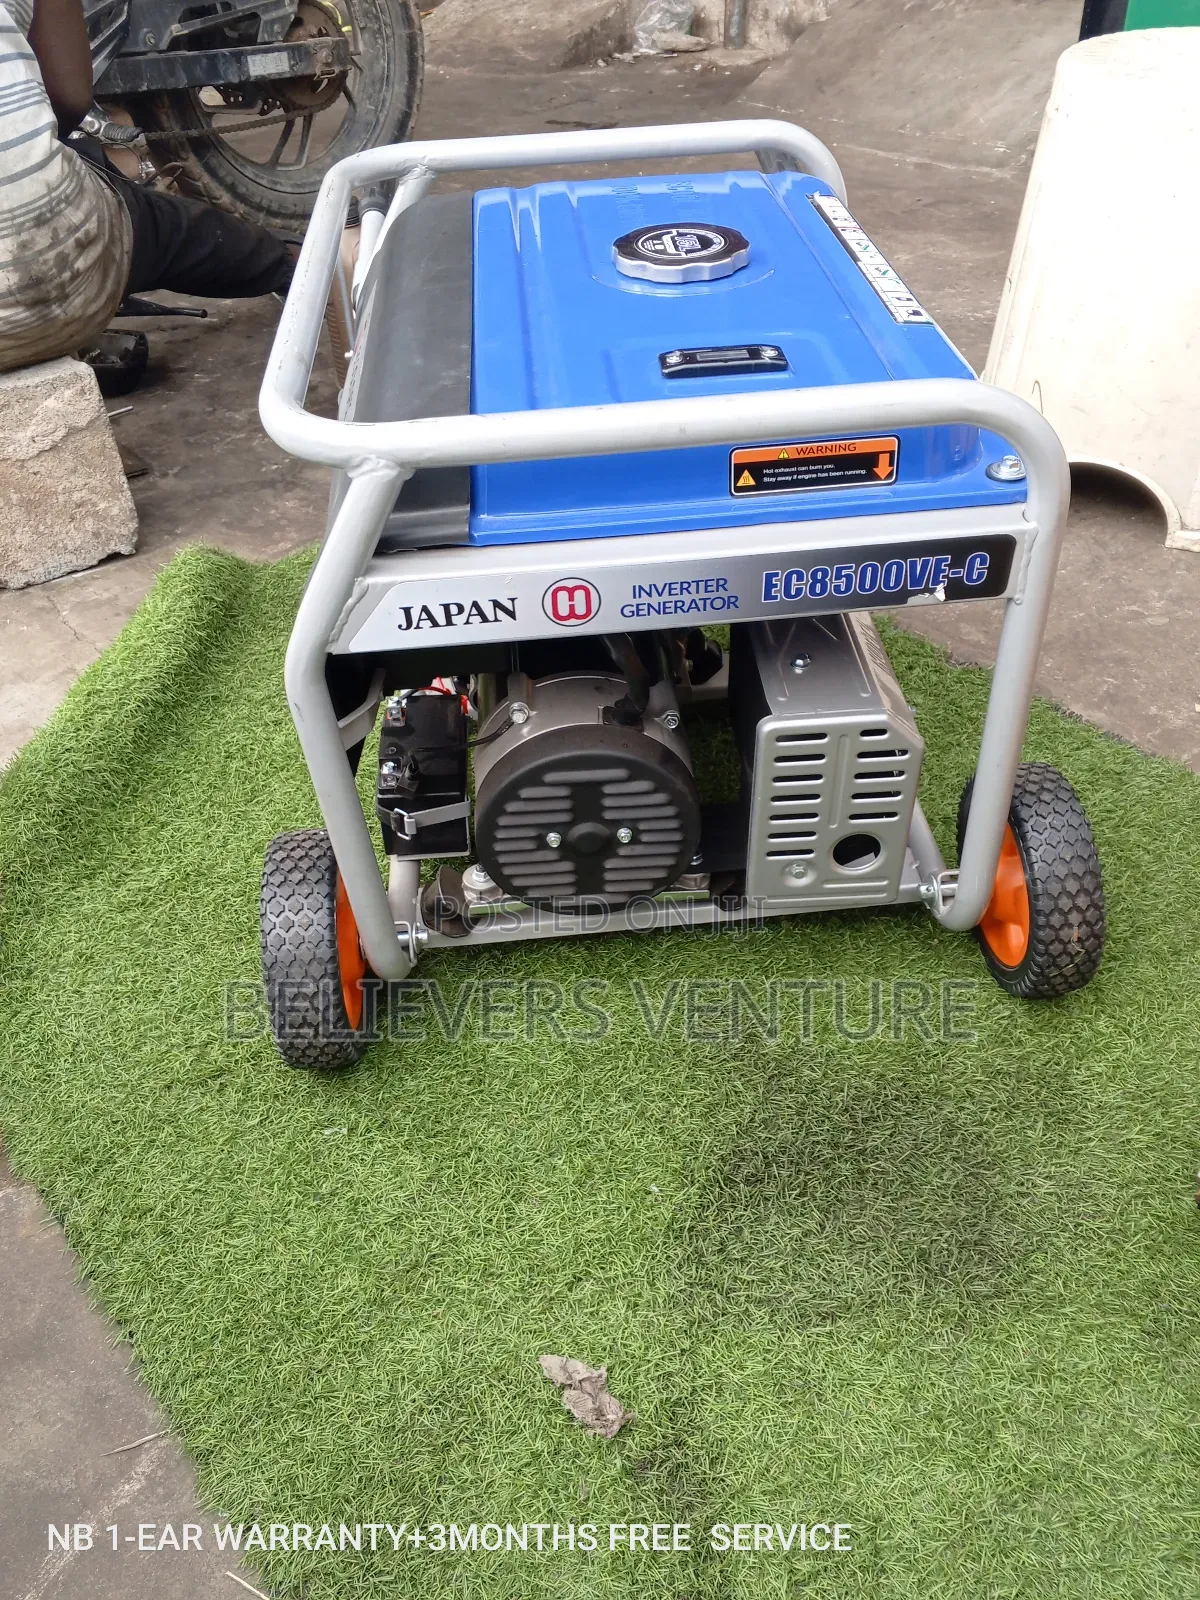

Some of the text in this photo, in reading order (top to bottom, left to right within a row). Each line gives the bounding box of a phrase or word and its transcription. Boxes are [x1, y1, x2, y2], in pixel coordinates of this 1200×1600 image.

[795, 443, 857, 456] WARNING
[632, 577, 729, 600] INVERTER
[761, 552, 990, 603] EC8500VE-C
[397, 597, 518, 631] JAPAN
[620, 595, 740, 618] GENERATOR
